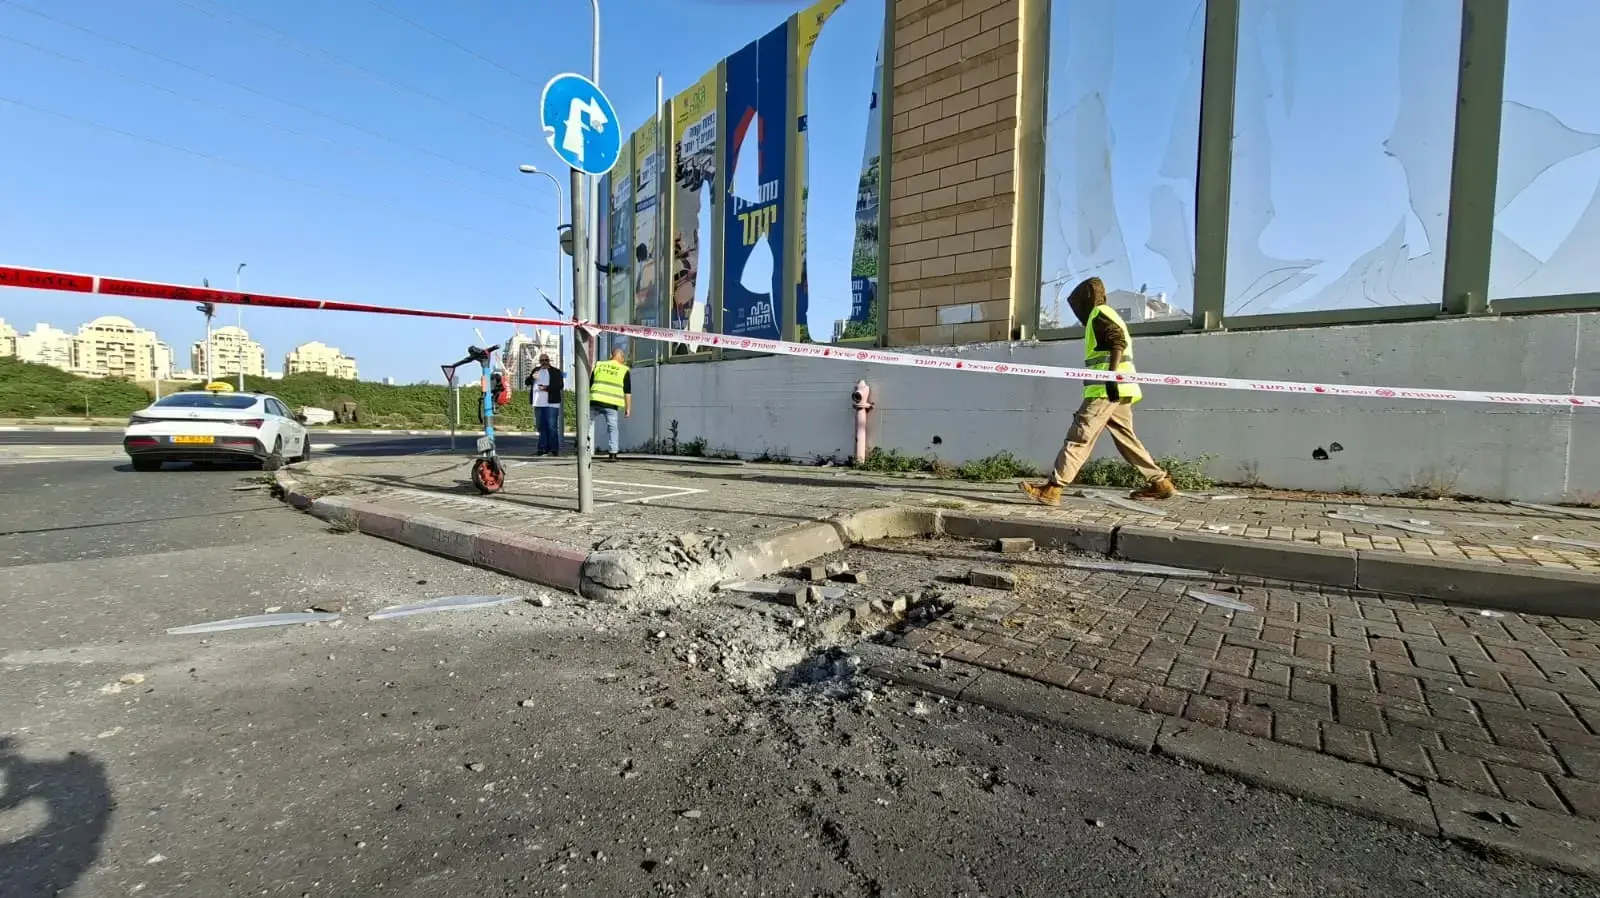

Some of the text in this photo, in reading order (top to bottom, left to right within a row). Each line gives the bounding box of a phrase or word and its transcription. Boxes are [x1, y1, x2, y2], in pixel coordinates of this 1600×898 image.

[737, 203, 777, 247] יותר
[683, 334, 701, 343] מעבר
[721, 338, 740, 346] ישראל
[751, 341, 777, 350] משטרת
[788, 346, 806, 355] מעבר
[832, 350, 856, 358] ישראל
[914, 358, 937, 367] מעבר
[967, 363, 994, 371] ישראל
[1010, 367, 1047, 376] משטרת
[1063, 371, 1092, 379] מעבר
[1129, 375, 1162, 383] ישראל
